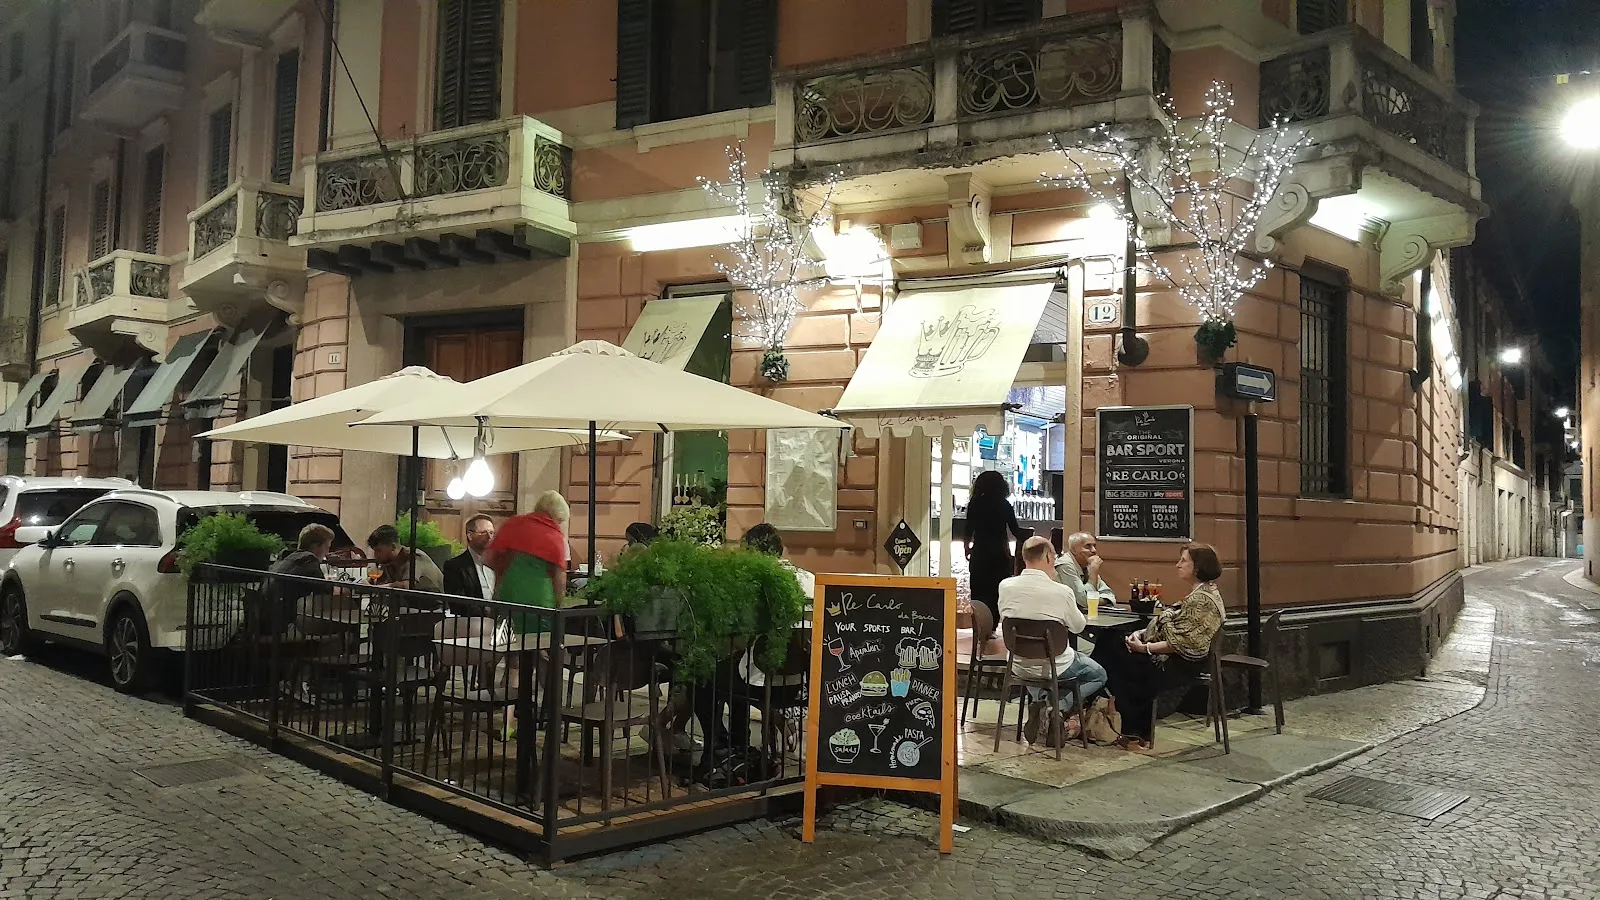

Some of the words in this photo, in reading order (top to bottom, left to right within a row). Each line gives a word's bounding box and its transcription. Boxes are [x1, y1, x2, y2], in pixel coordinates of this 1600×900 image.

[1094, 306, 1111, 320] 12
[1106, 443, 1134, 457] BAR
[1136, 443, 1185, 456] SPORT
[1112, 471, 1130, 481] RE
[1131, 470, 1179, 481] CARLO
[1113, 513, 1139, 521] 10AM
[1152, 513, 1178, 521] 10AM
[1113, 520, 1139, 529] 02AM
[1152, 521, 1178, 529] 03AM
[893, 544, 913, 557] Open
[841, 592, 862, 616] Re
[866, 593, 904, 610] Carlo
[834, 621, 857, 635] YOUR
[862, 623, 891, 634] SPORTS
[826, 674, 857, 694] LUNCH
[911, 679, 940, 701] DINNER
[904, 727, 926, 741] PASTA
